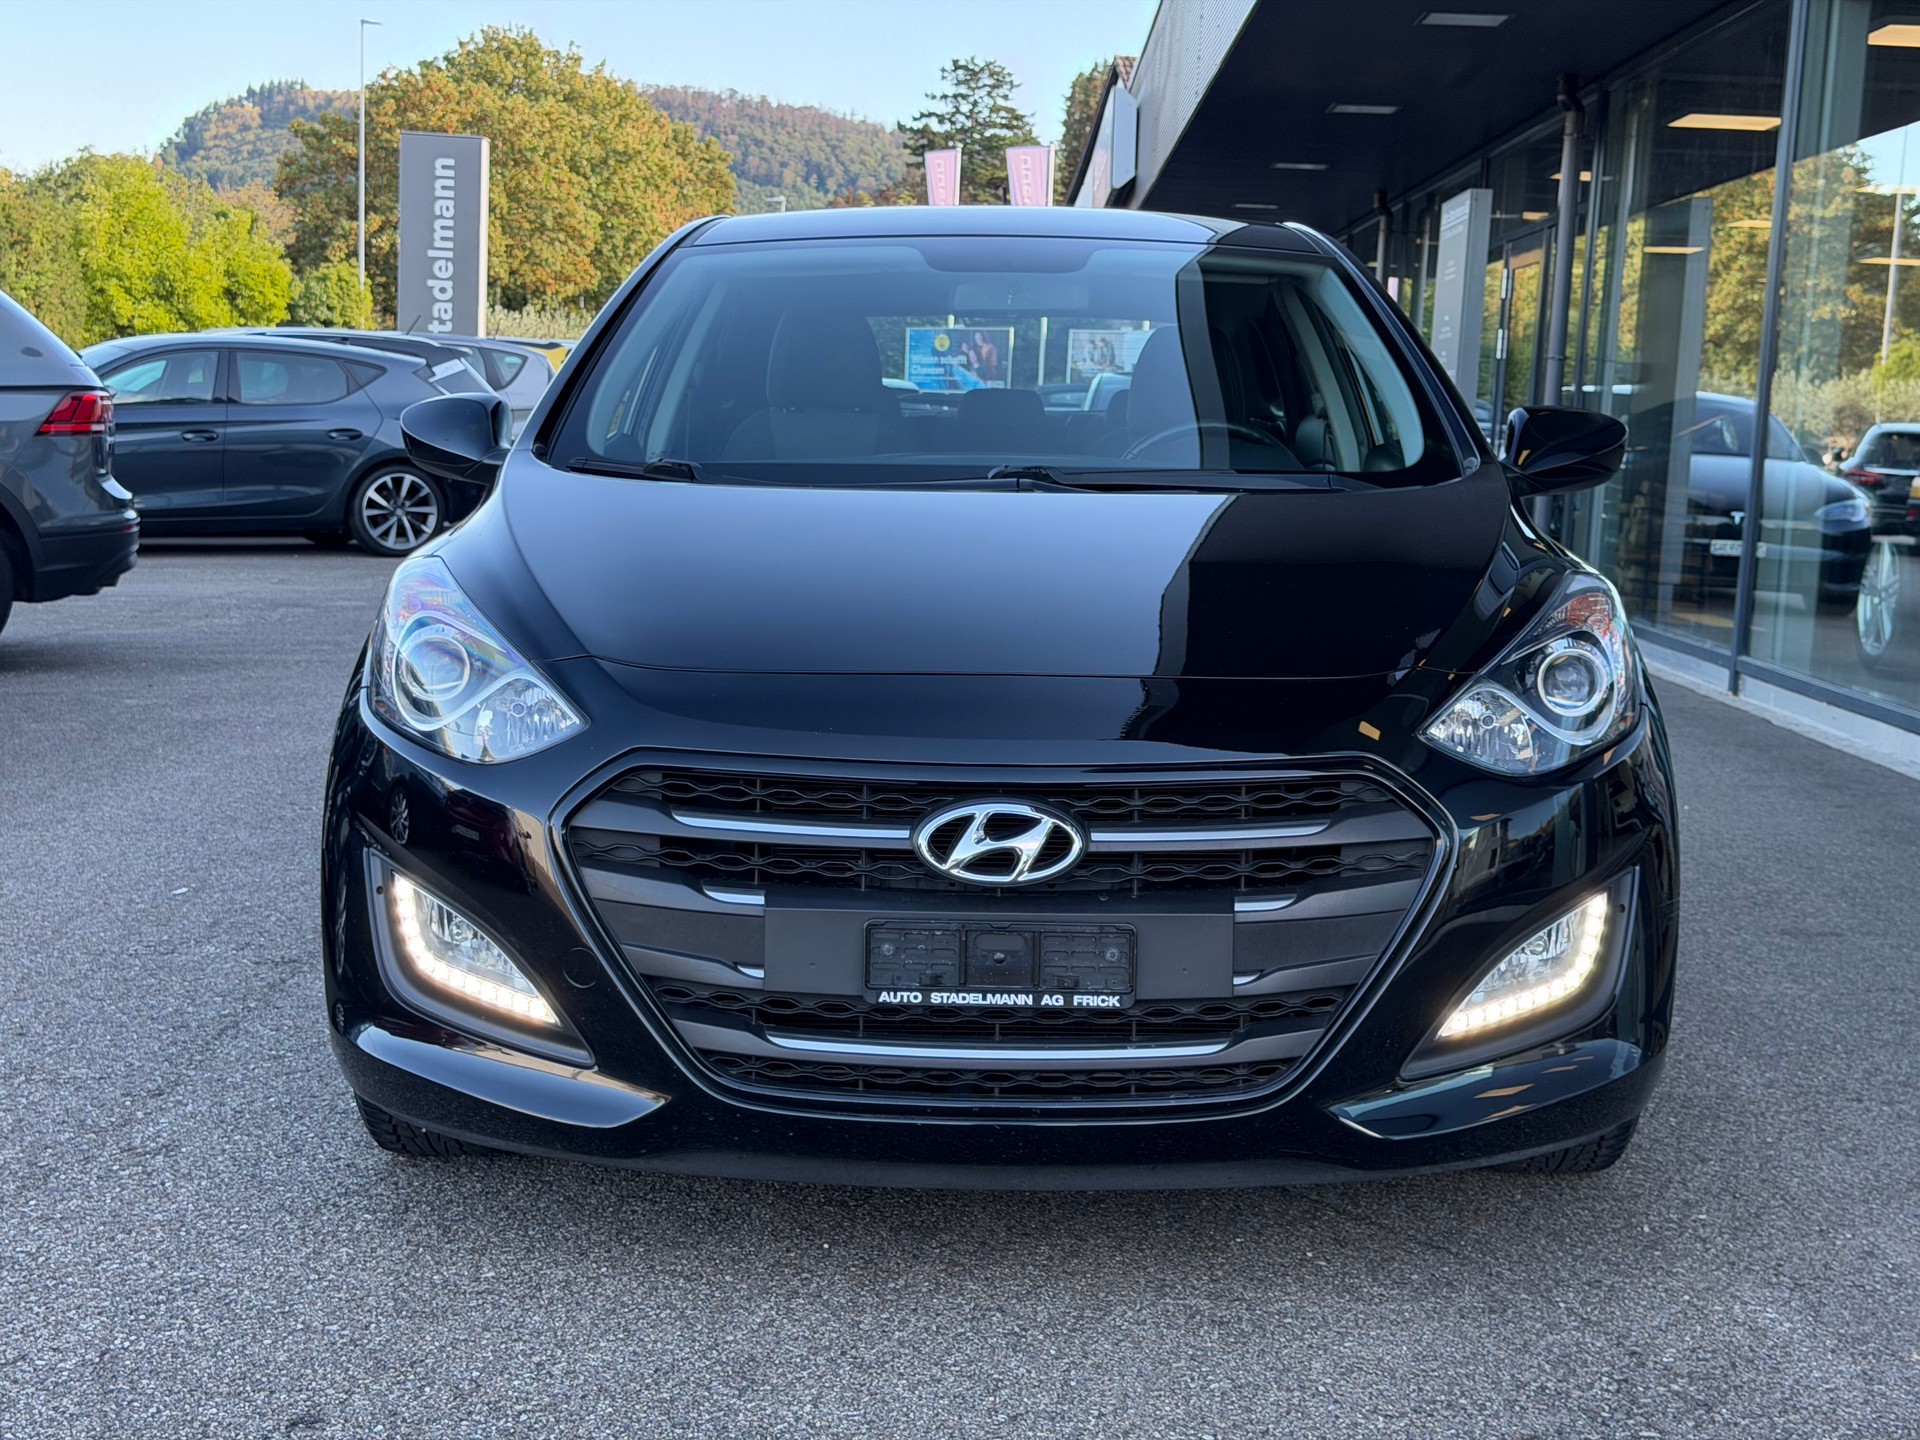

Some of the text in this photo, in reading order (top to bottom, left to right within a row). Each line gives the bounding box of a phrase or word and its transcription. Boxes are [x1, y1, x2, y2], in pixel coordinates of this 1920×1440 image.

[878, 991, 1120, 1007] AUTO STADELMANN AG FRICK
